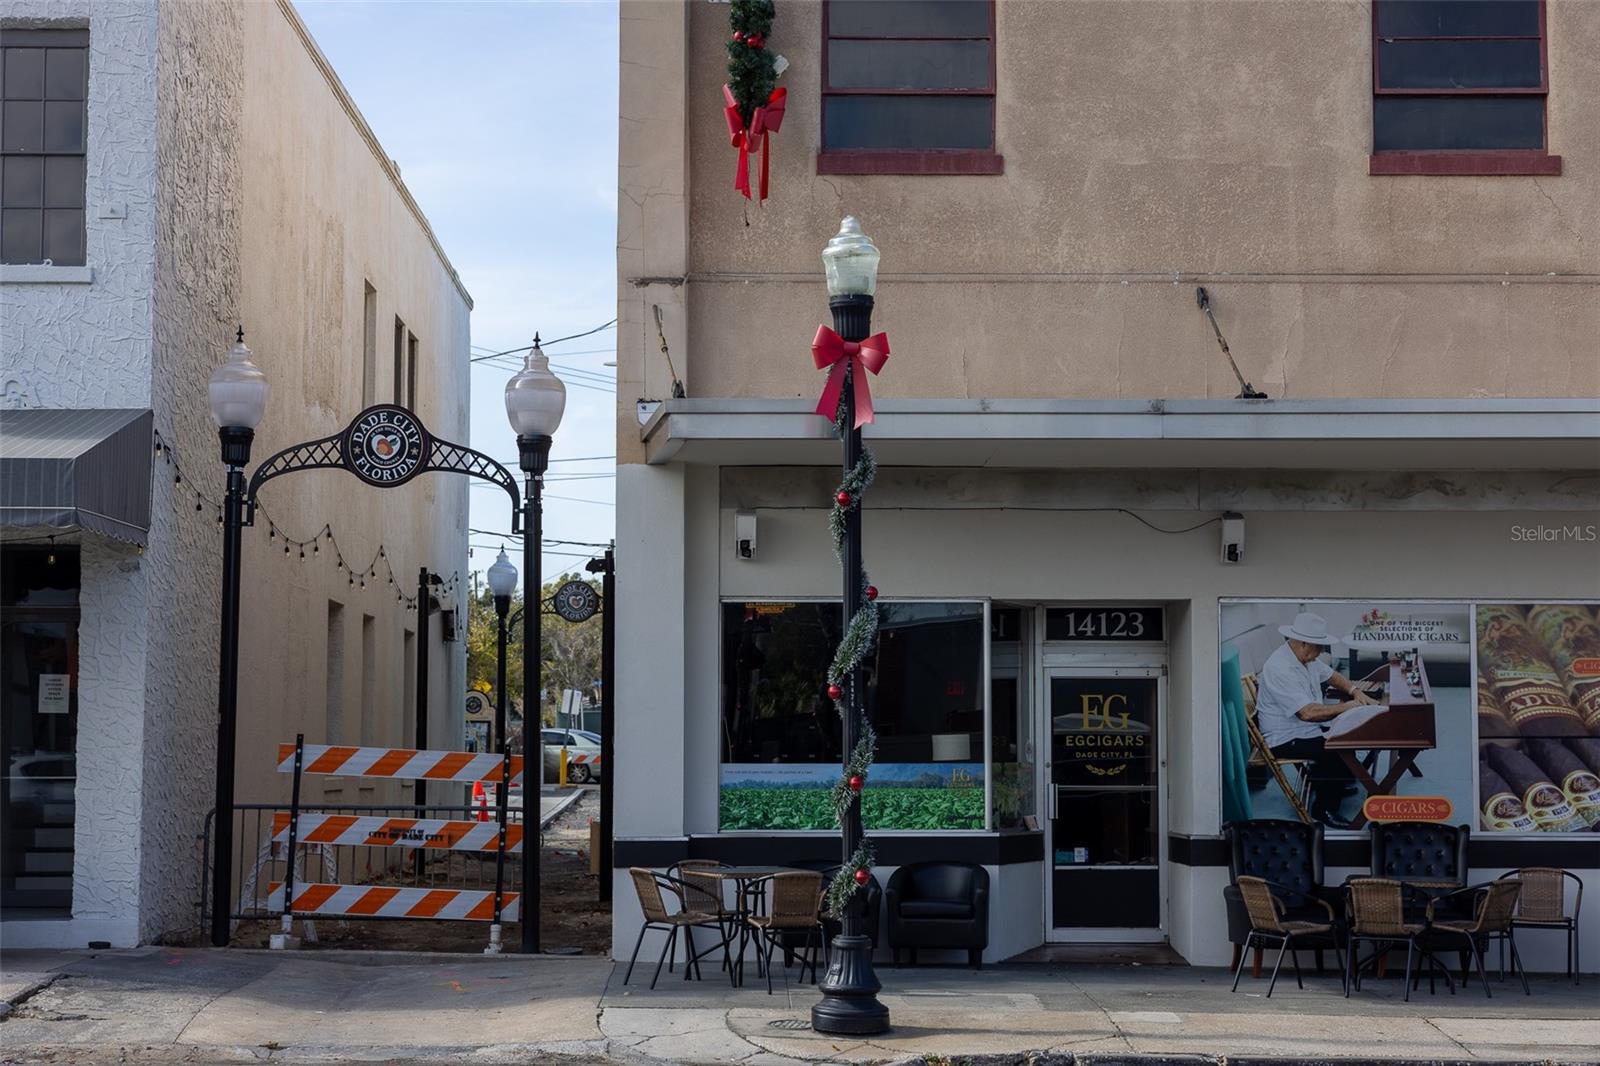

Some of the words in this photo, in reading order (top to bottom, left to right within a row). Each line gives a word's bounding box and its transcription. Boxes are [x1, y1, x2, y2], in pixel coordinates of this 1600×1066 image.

[353, 412, 389, 443] DADE
[393, 415, 420, 444] CITY
[355, 456, 417, 480] FLORIDA
[1065, 612, 1144, 637] 14123
[1352, 632, 1416, 641] HANDMADE
[1418, 632, 1459, 641] CIGARS
[1080, 694, 1130, 731] EG
[1065, 735, 1145, 746] EGCIGARS
[1381, 802, 1436, 814] CIGARS
